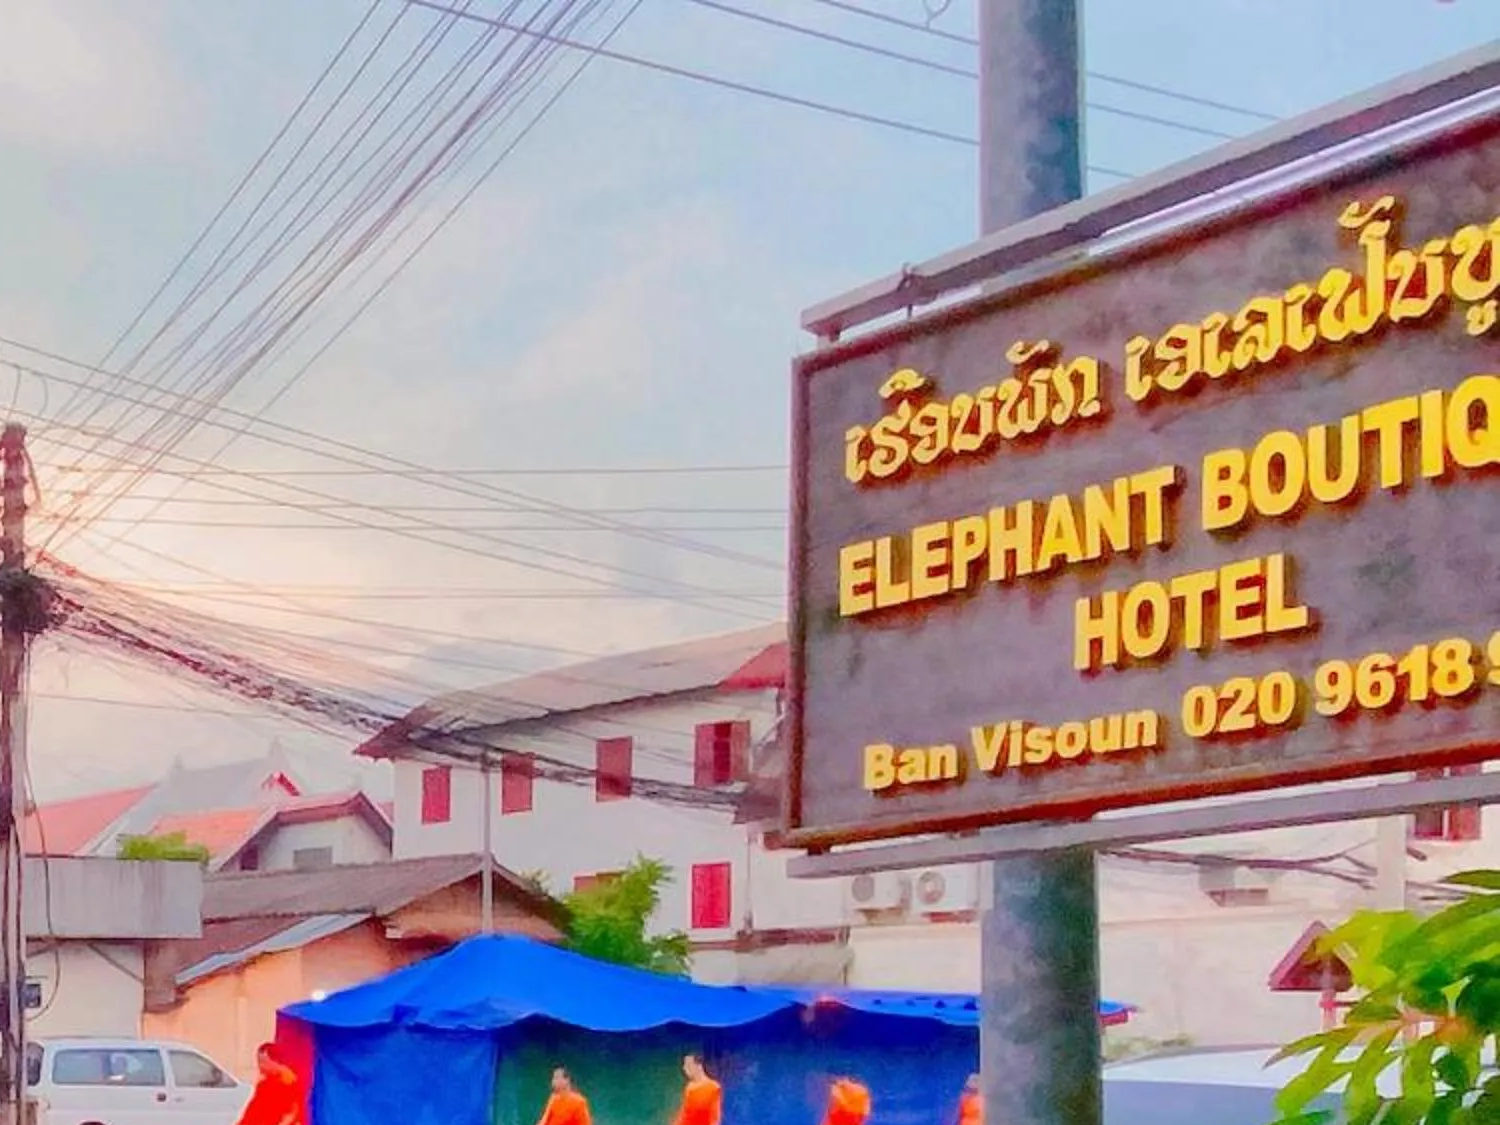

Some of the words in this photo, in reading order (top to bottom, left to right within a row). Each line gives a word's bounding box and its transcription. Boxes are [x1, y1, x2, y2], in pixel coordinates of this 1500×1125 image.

[839, 464, 1176, 618] ELEPHANT
[1201, 374, 1500, 532] BOUTIQ
[1073, 552, 1309, 671] HOTEL
[863, 742, 959, 792] Ban
[971, 708, 1159, 772] Visoun
[1180, 670, 1297, 738] 020
[1312, 637, 1476, 716] 9618
